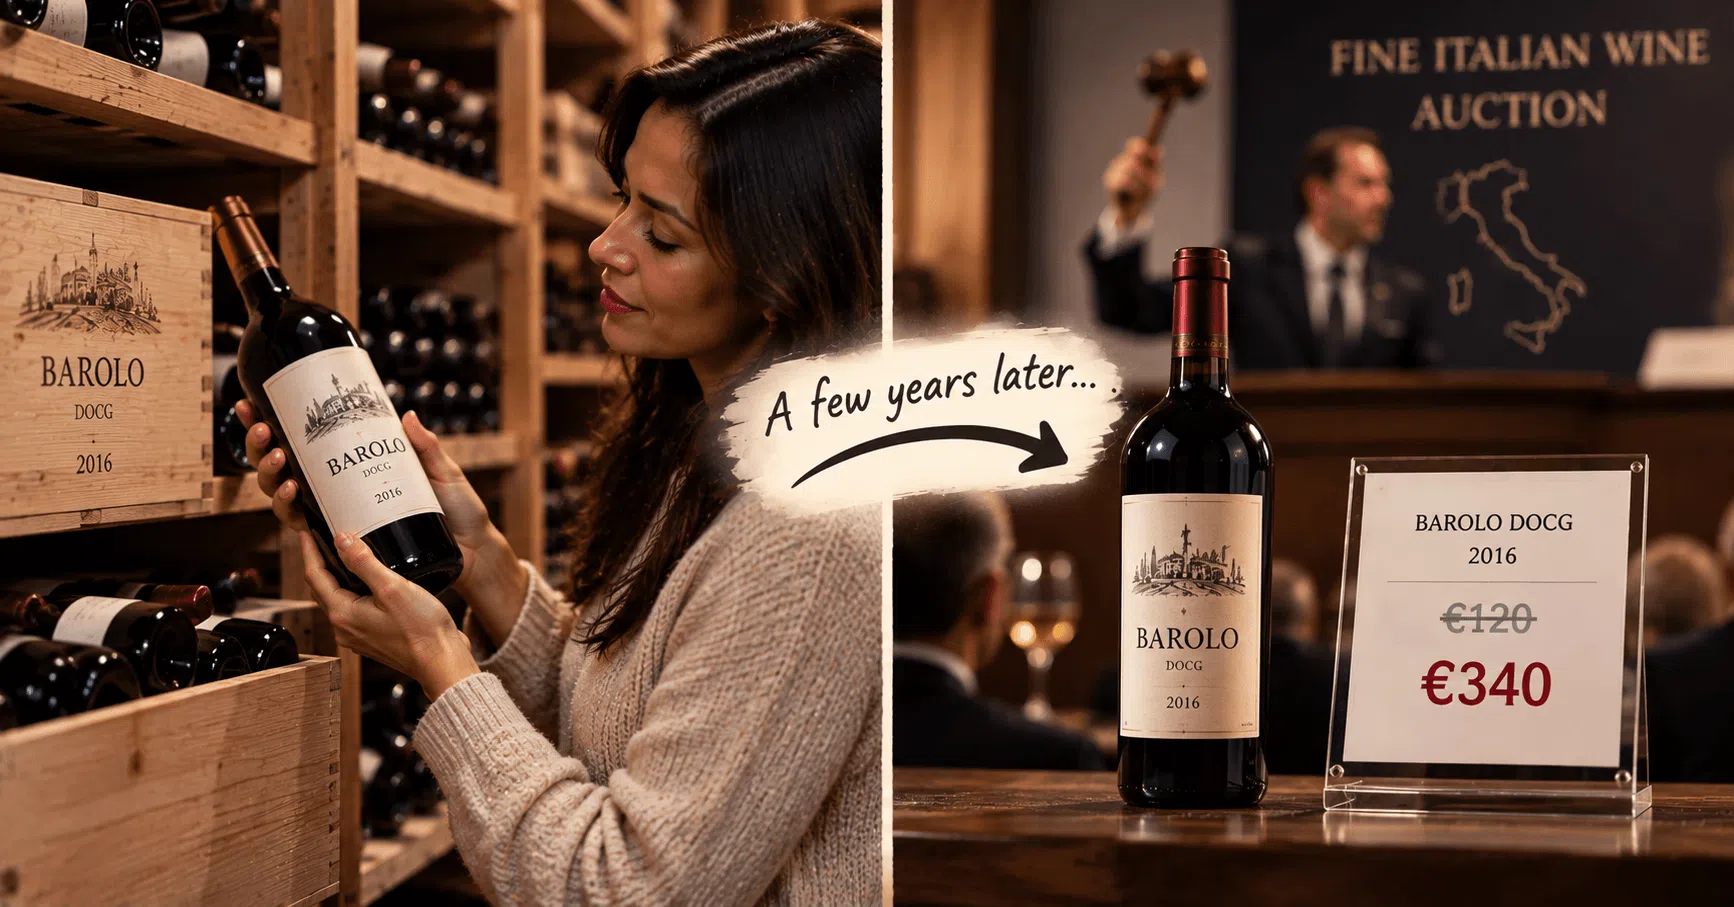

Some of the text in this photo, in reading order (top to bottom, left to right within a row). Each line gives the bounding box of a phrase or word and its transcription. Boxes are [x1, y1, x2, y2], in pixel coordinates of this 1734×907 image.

[1330, 28, 1710, 76] FINE ITALIAN WINE
[1411, 90, 1608, 131] AUCTION
[41, 355, 145, 388] BAROLO
[75, 403, 113, 420] DOCG
[76, 453, 113, 475] 2016
[326, 437, 406, 477] BAROLO
[362, 461, 392, 478] DOCG
[374, 487, 403, 504] 2016
[1415, 513, 1573, 532] BAROLO DOCG
[1468, 546, 1517, 565] 2016
[1440, 602, 1536, 634] €120
[1136, 627, 1239, 650] BAROLO
[1166, 660, 1203, 671] DOCG
[1420, 659, 1552, 707] €340
[1166, 696, 1200, 709] 2016
